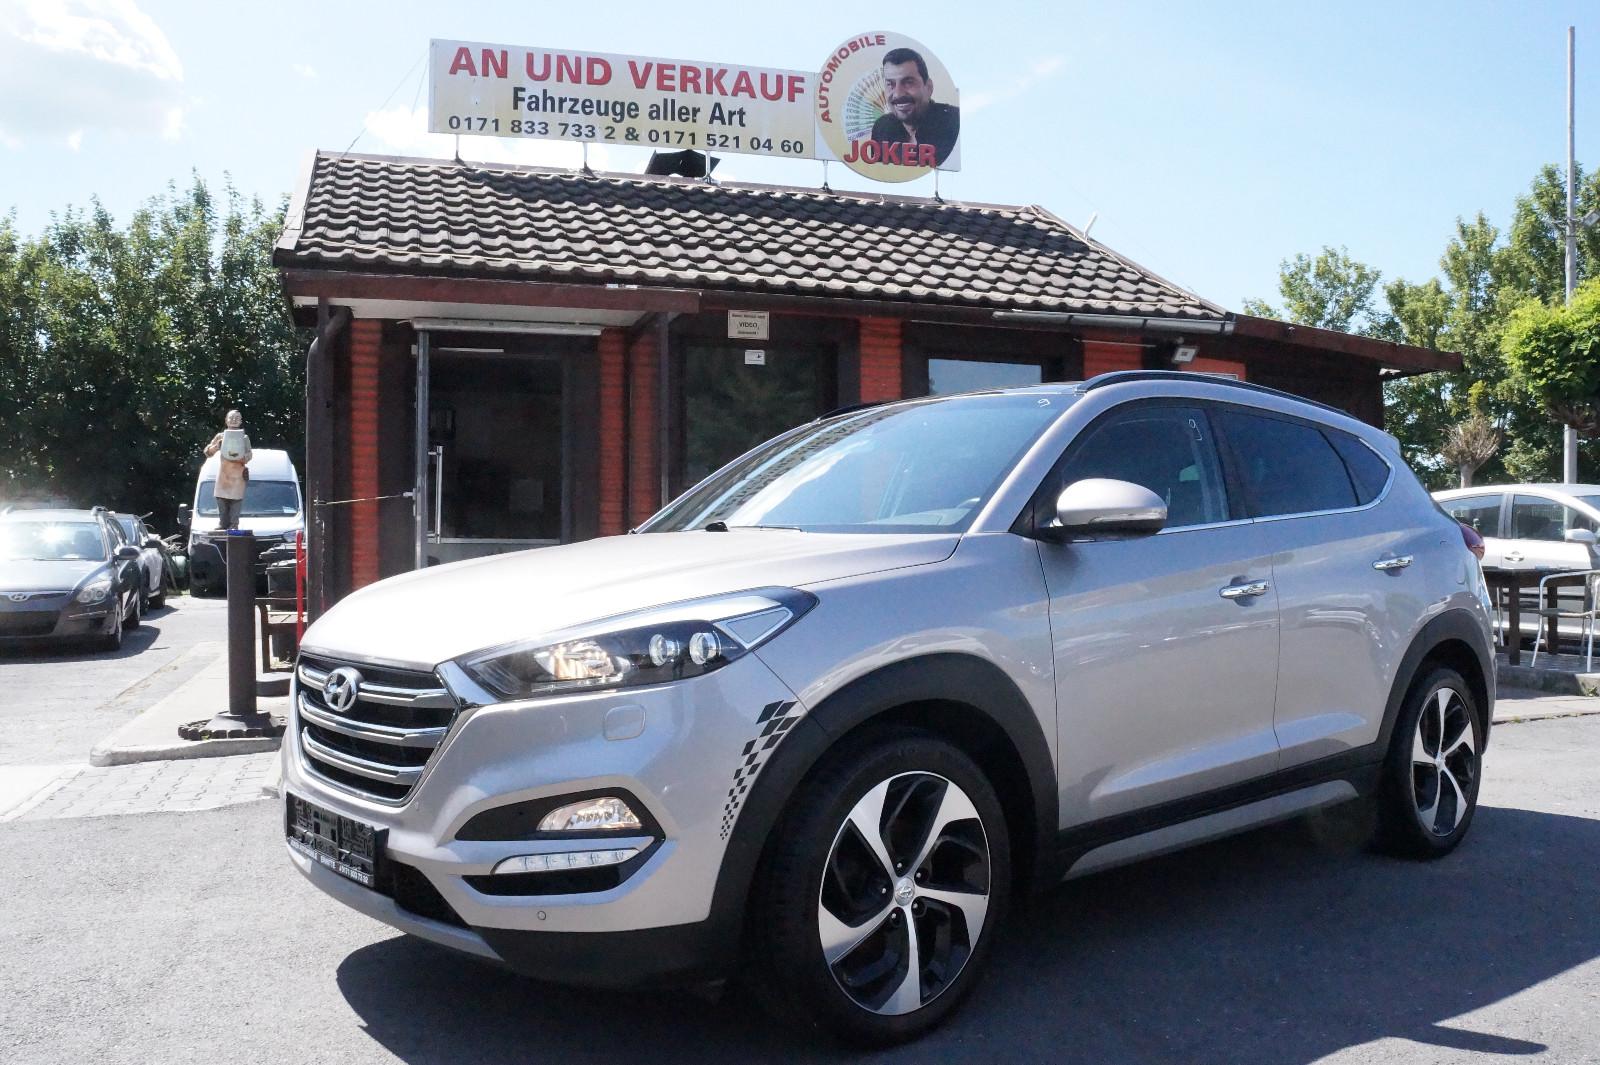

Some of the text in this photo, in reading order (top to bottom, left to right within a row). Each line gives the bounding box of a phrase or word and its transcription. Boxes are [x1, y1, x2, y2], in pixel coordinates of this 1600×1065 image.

[448, 46, 806, 103] AN UND VERKAUF
[818, 34, 886, 123] AUTOMOBILE
[512, 86, 747, 128] Fahrzeuge aller Art
[448, 115, 500, 132] 0171
[510, 119, 550, 136] 833
[625, 127, 640, 142] &
[648, 129, 696, 146] 0171
[706, 133, 741, 149] 521
[750, 136, 774, 152] 04
[780, 139, 805, 154] 60
[843, 139, 937, 169] JOKER
